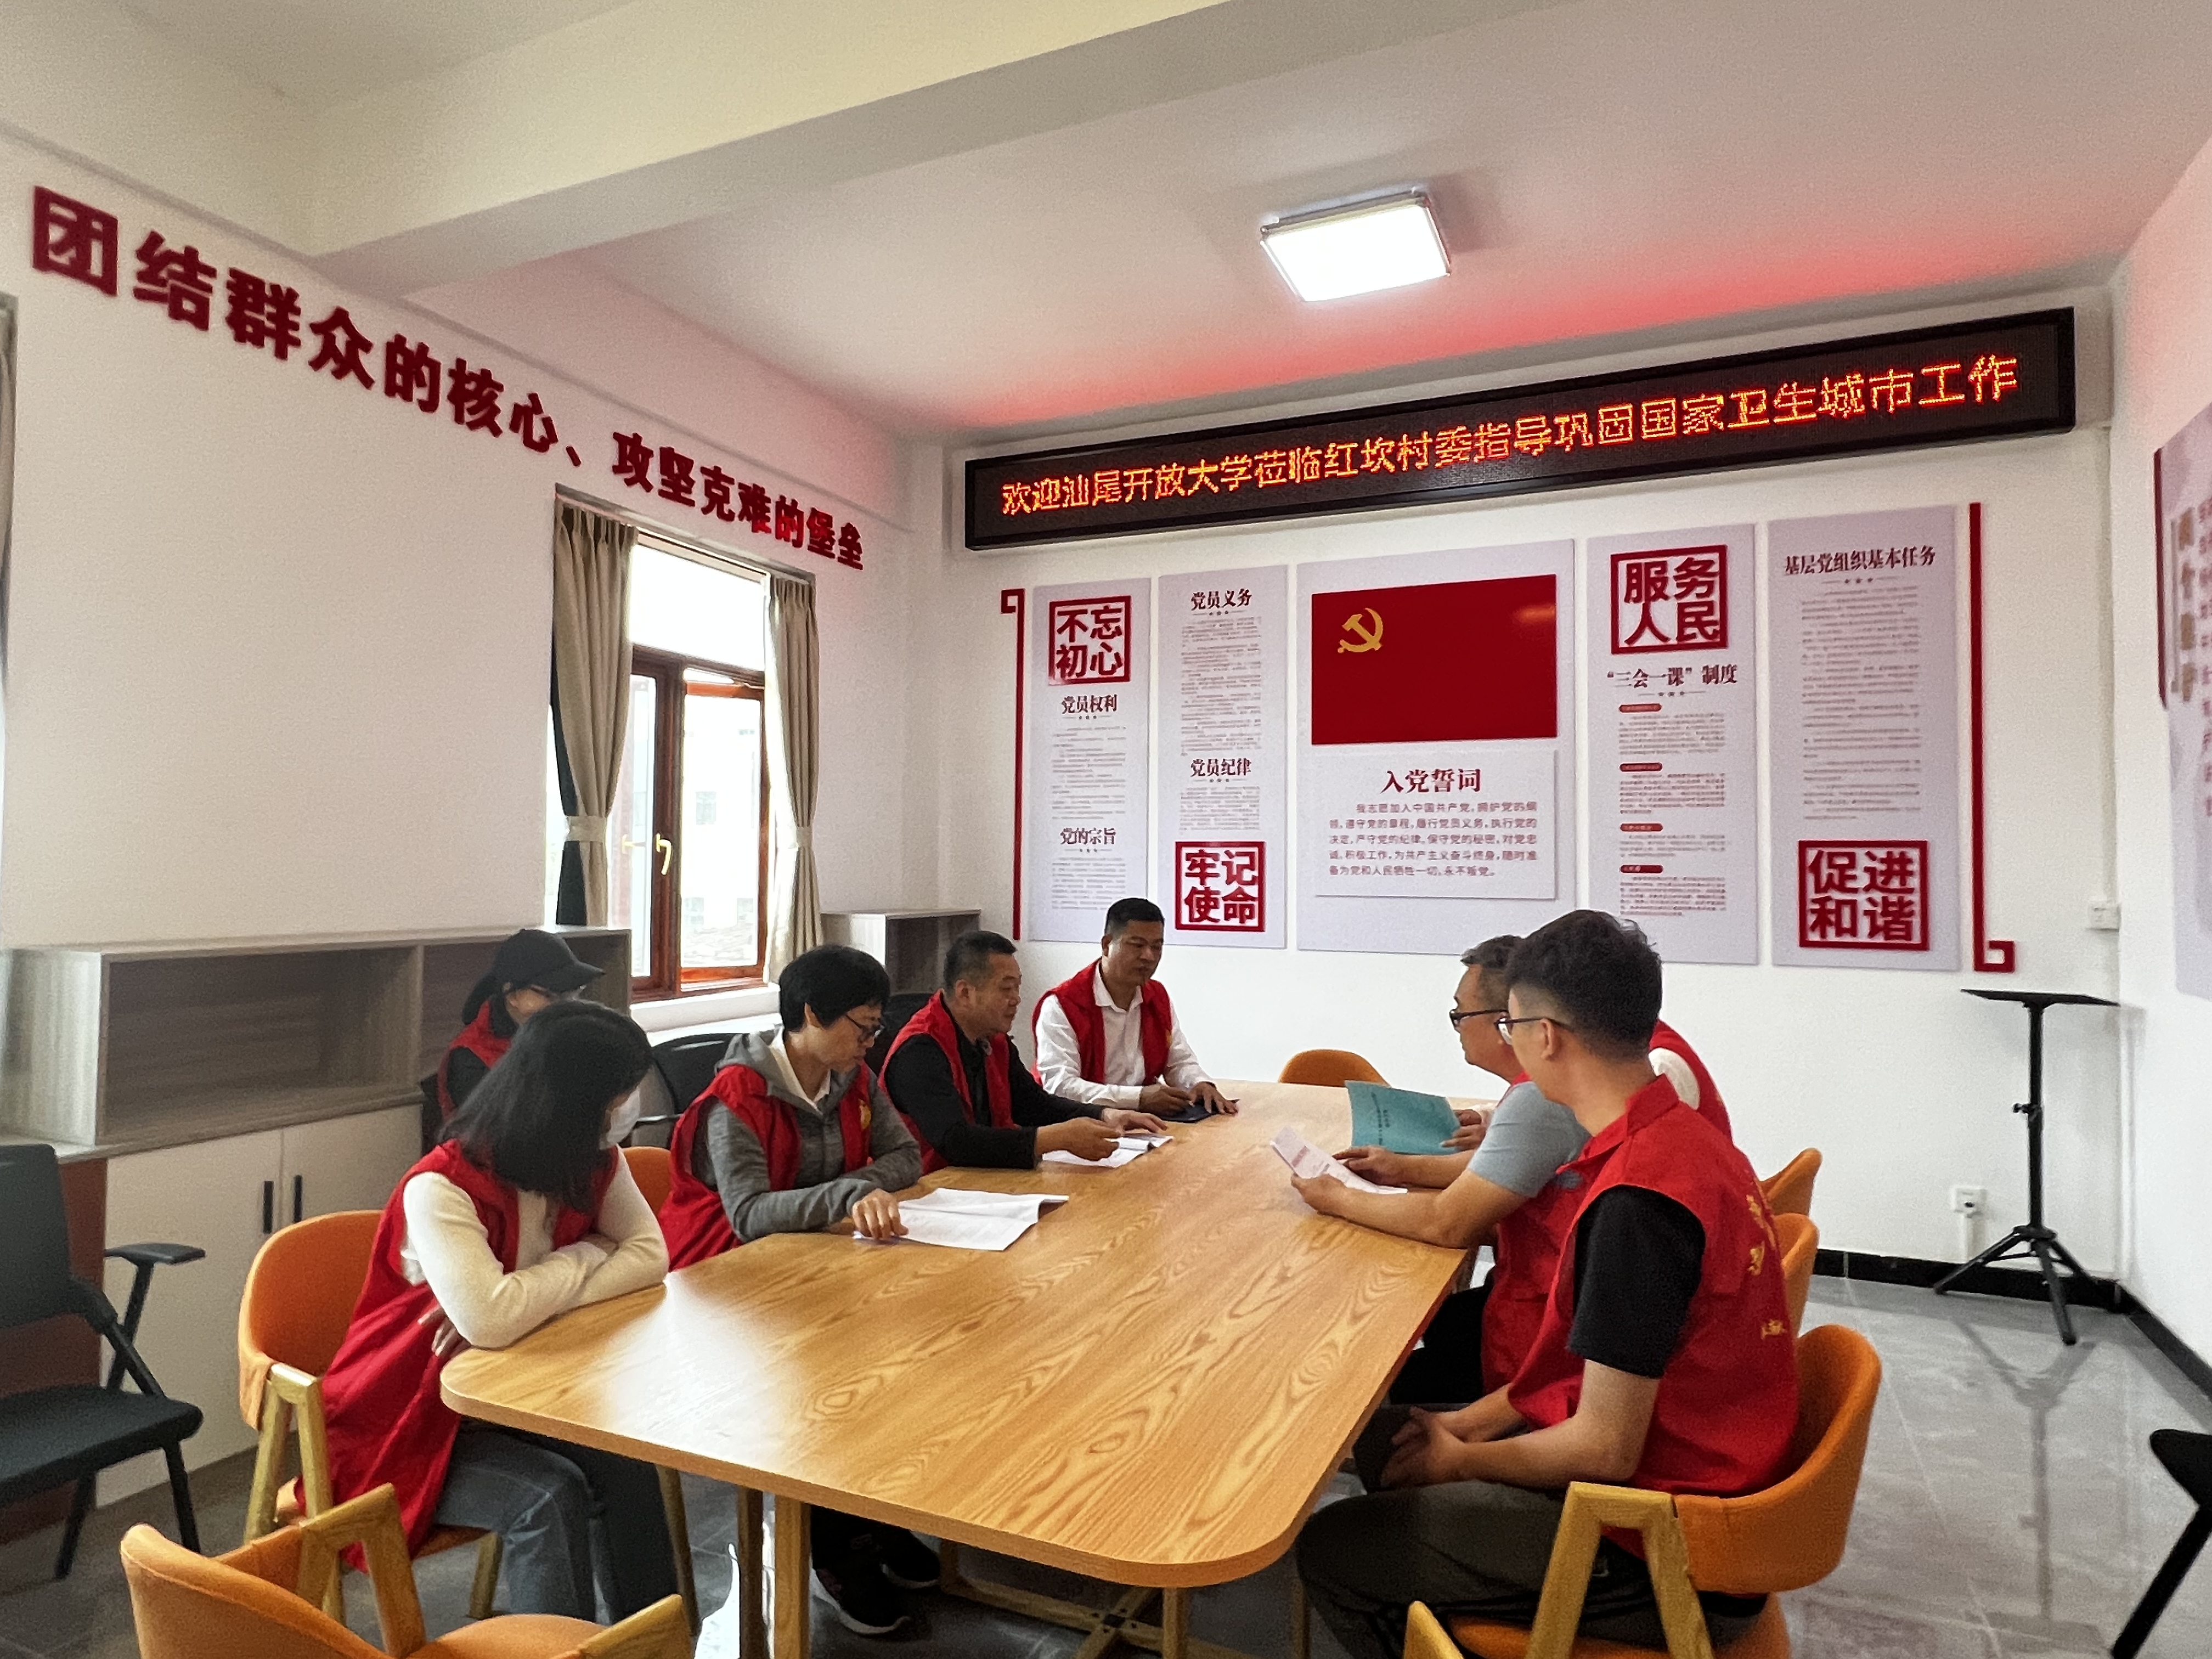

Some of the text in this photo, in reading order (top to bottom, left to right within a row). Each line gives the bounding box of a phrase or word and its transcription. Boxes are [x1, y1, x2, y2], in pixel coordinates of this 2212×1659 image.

[32, 186, 864, 571] 团结群众的核心、攻坚克难的堡垒
[1000, 352, 2020, 517] 欢迎汕尾开放大学莅临红坎村委指导巩固国家卫生城市工作
[1623, 556, 1719, 603] 服务
[1783, 544, 1937, 577] 基层党组织基本任务
[1190, 588, 1252, 611] 党员义务
[1057, 605, 1124, 642] 不忘
[1624, 601, 1720, 646] 人民
[1056, 643, 1124, 679] 初心
[1061, 694, 1118, 714] 党员权利
[1190, 758, 1252, 777] 党员纪律
[1380, 768, 1481, 793] 入党誓词
[1060, 827, 1116, 845] 党的宗旨
[1184, 848, 1258, 887] 牢记
[1808, 849, 1915, 894] 促进
[1184, 885, 1258, 924] 使命
[1808, 894, 1915, 943] 和谐
